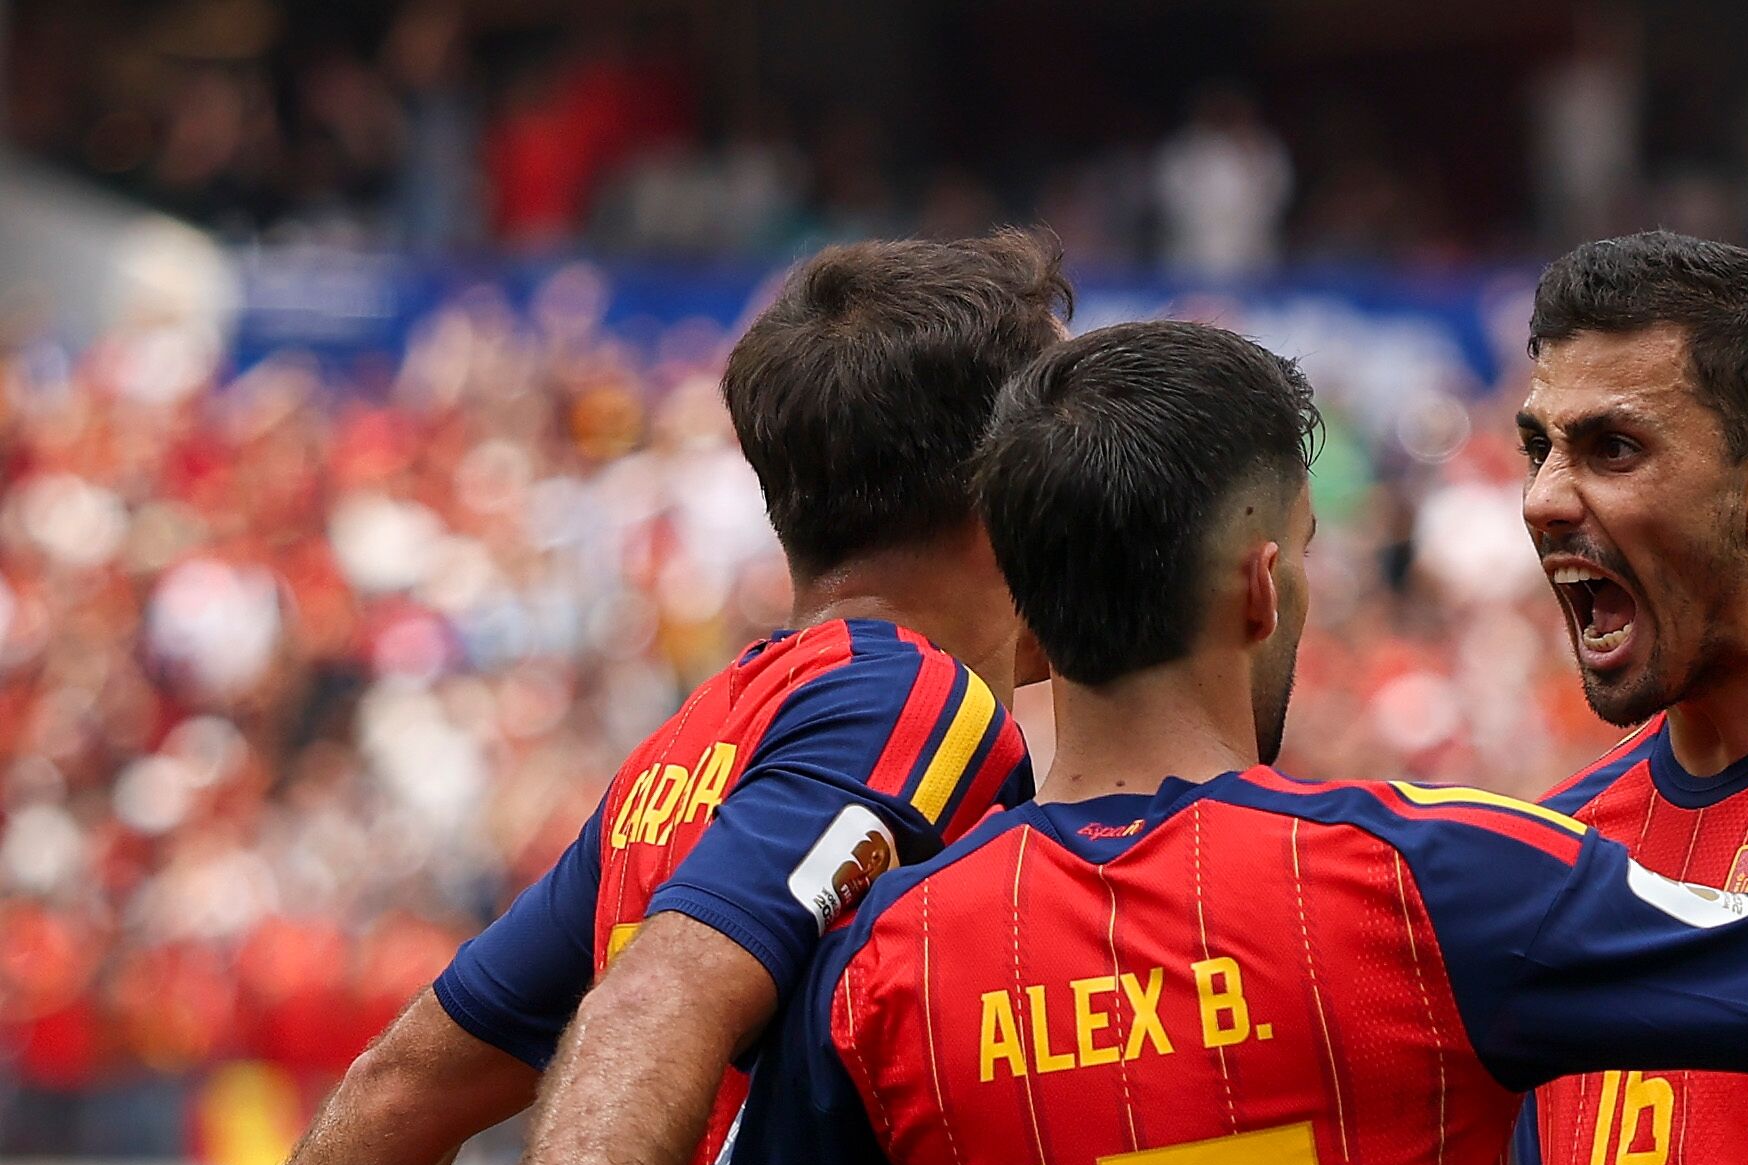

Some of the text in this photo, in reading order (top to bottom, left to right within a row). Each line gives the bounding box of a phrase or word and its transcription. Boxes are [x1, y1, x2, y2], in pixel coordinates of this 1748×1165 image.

[611, 741, 738, 850] GARIA
[980, 956, 1274, 1083] ALEX B.
